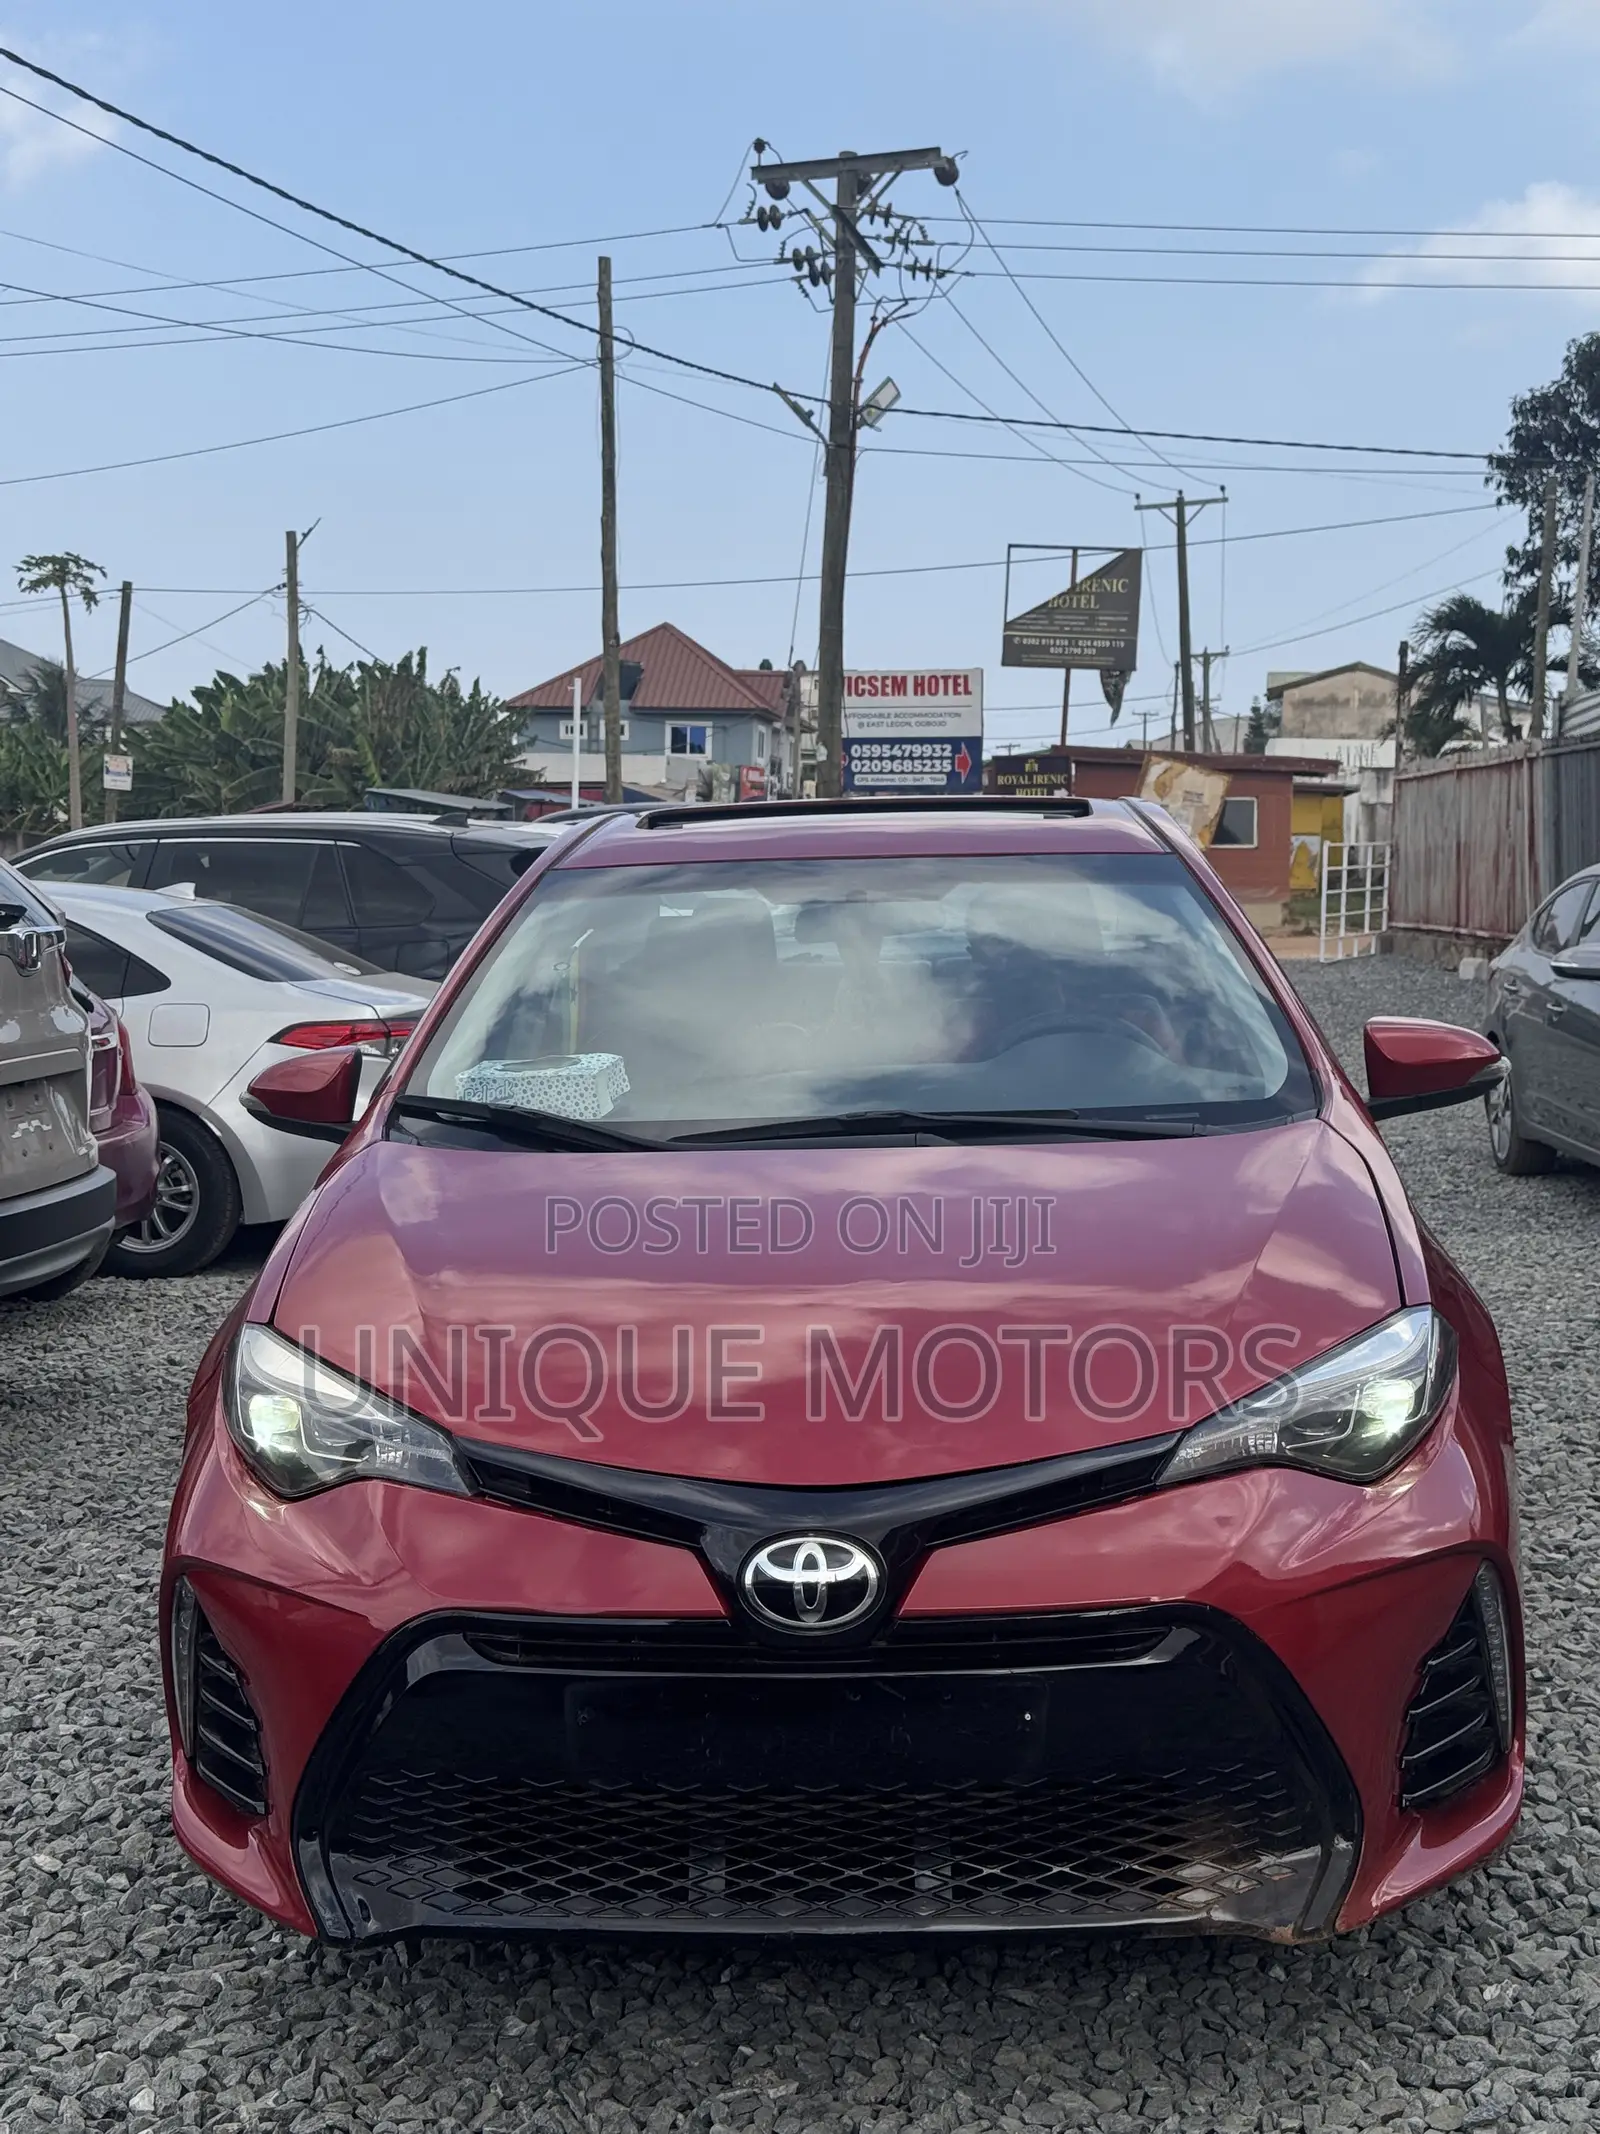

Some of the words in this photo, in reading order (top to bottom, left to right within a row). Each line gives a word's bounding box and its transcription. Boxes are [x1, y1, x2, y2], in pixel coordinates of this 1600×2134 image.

[1048, 594, 1100, 609] HOTEL
[844, 675, 908, 697] ICSEM
[913, 674, 973, 697] HOTEL
[851, 744, 953, 758] 0595479932
[851, 759, 953, 773] 0209685235
[997, 774, 1032, 785] ROYAL
[1033, 773, 1069, 785] IRENIC
[1015, 787, 1048, 797] HOTEL
